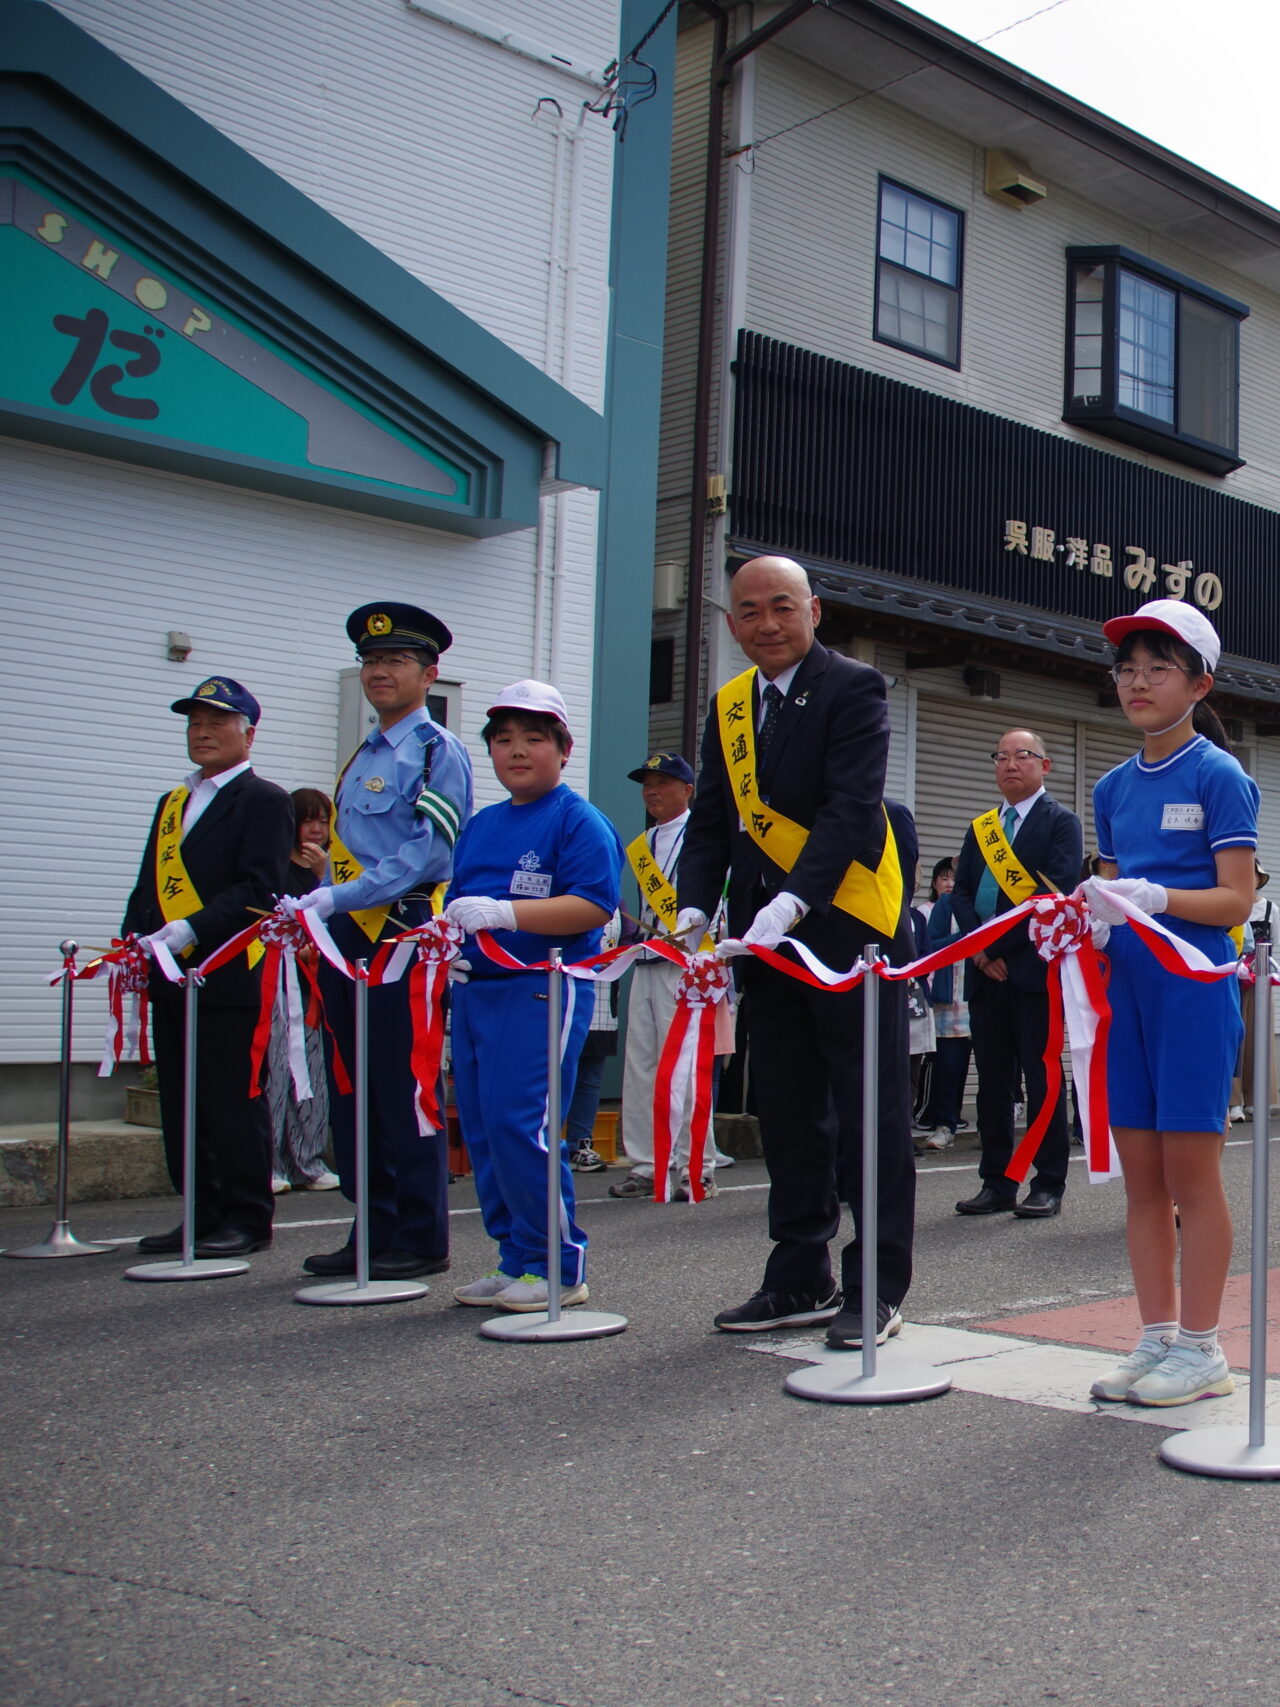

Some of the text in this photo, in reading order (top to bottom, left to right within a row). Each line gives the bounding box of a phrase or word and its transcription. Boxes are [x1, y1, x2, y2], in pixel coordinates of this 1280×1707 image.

[37, 213, 212, 337] SHOP
[51, 308, 161, 420] だ
[1003, 519, 1223, 611] 呉服・洋品 みずの
[725, 700, 774, 838] 交通安全
[979, 815, 1023, 887] 交通安全
